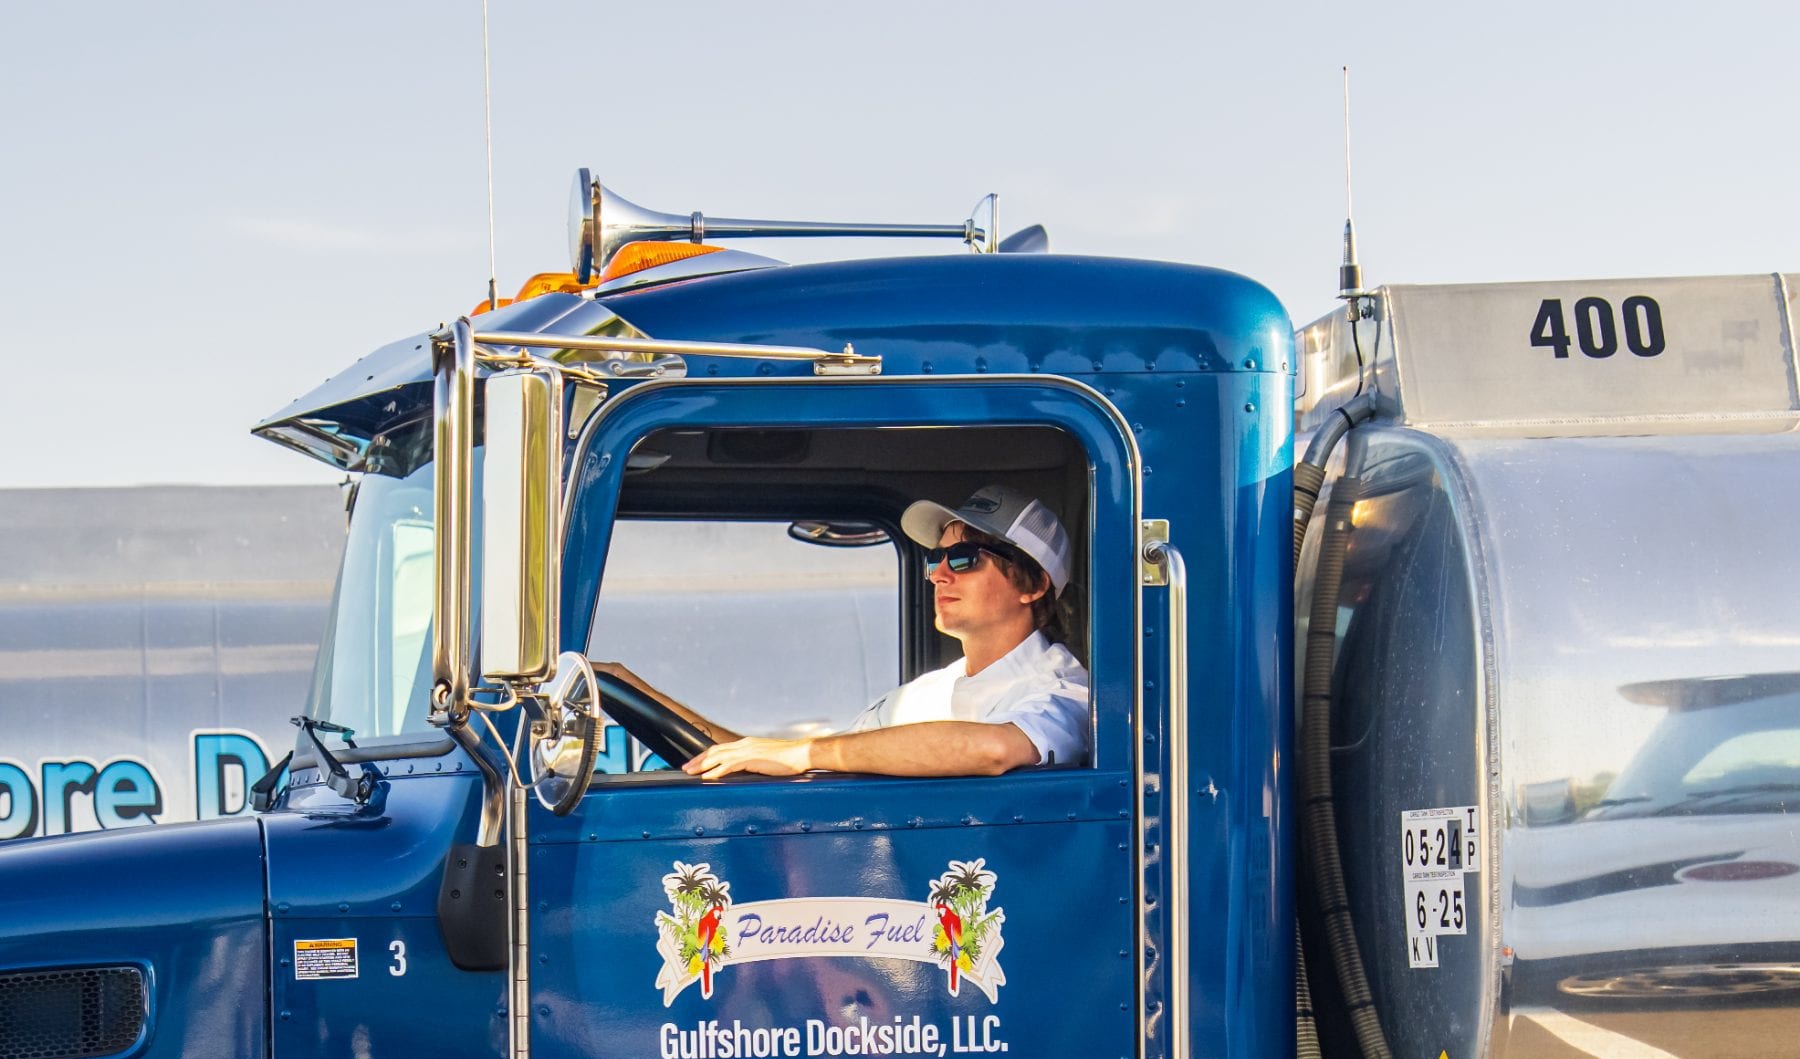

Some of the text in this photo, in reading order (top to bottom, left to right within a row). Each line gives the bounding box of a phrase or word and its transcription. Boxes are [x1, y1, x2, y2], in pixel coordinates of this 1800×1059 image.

[1530, 295, 1665, 359] 400
[1468, 841, 1475, 866] P
[1417, 889, 1463, 930] 6-25
[737, 913, 926, 949] Paradise Fuel
[389, 940, 407, 976] 3
[660, 1015, 1009, 1059] Gulfshore Dockside, LLC.
